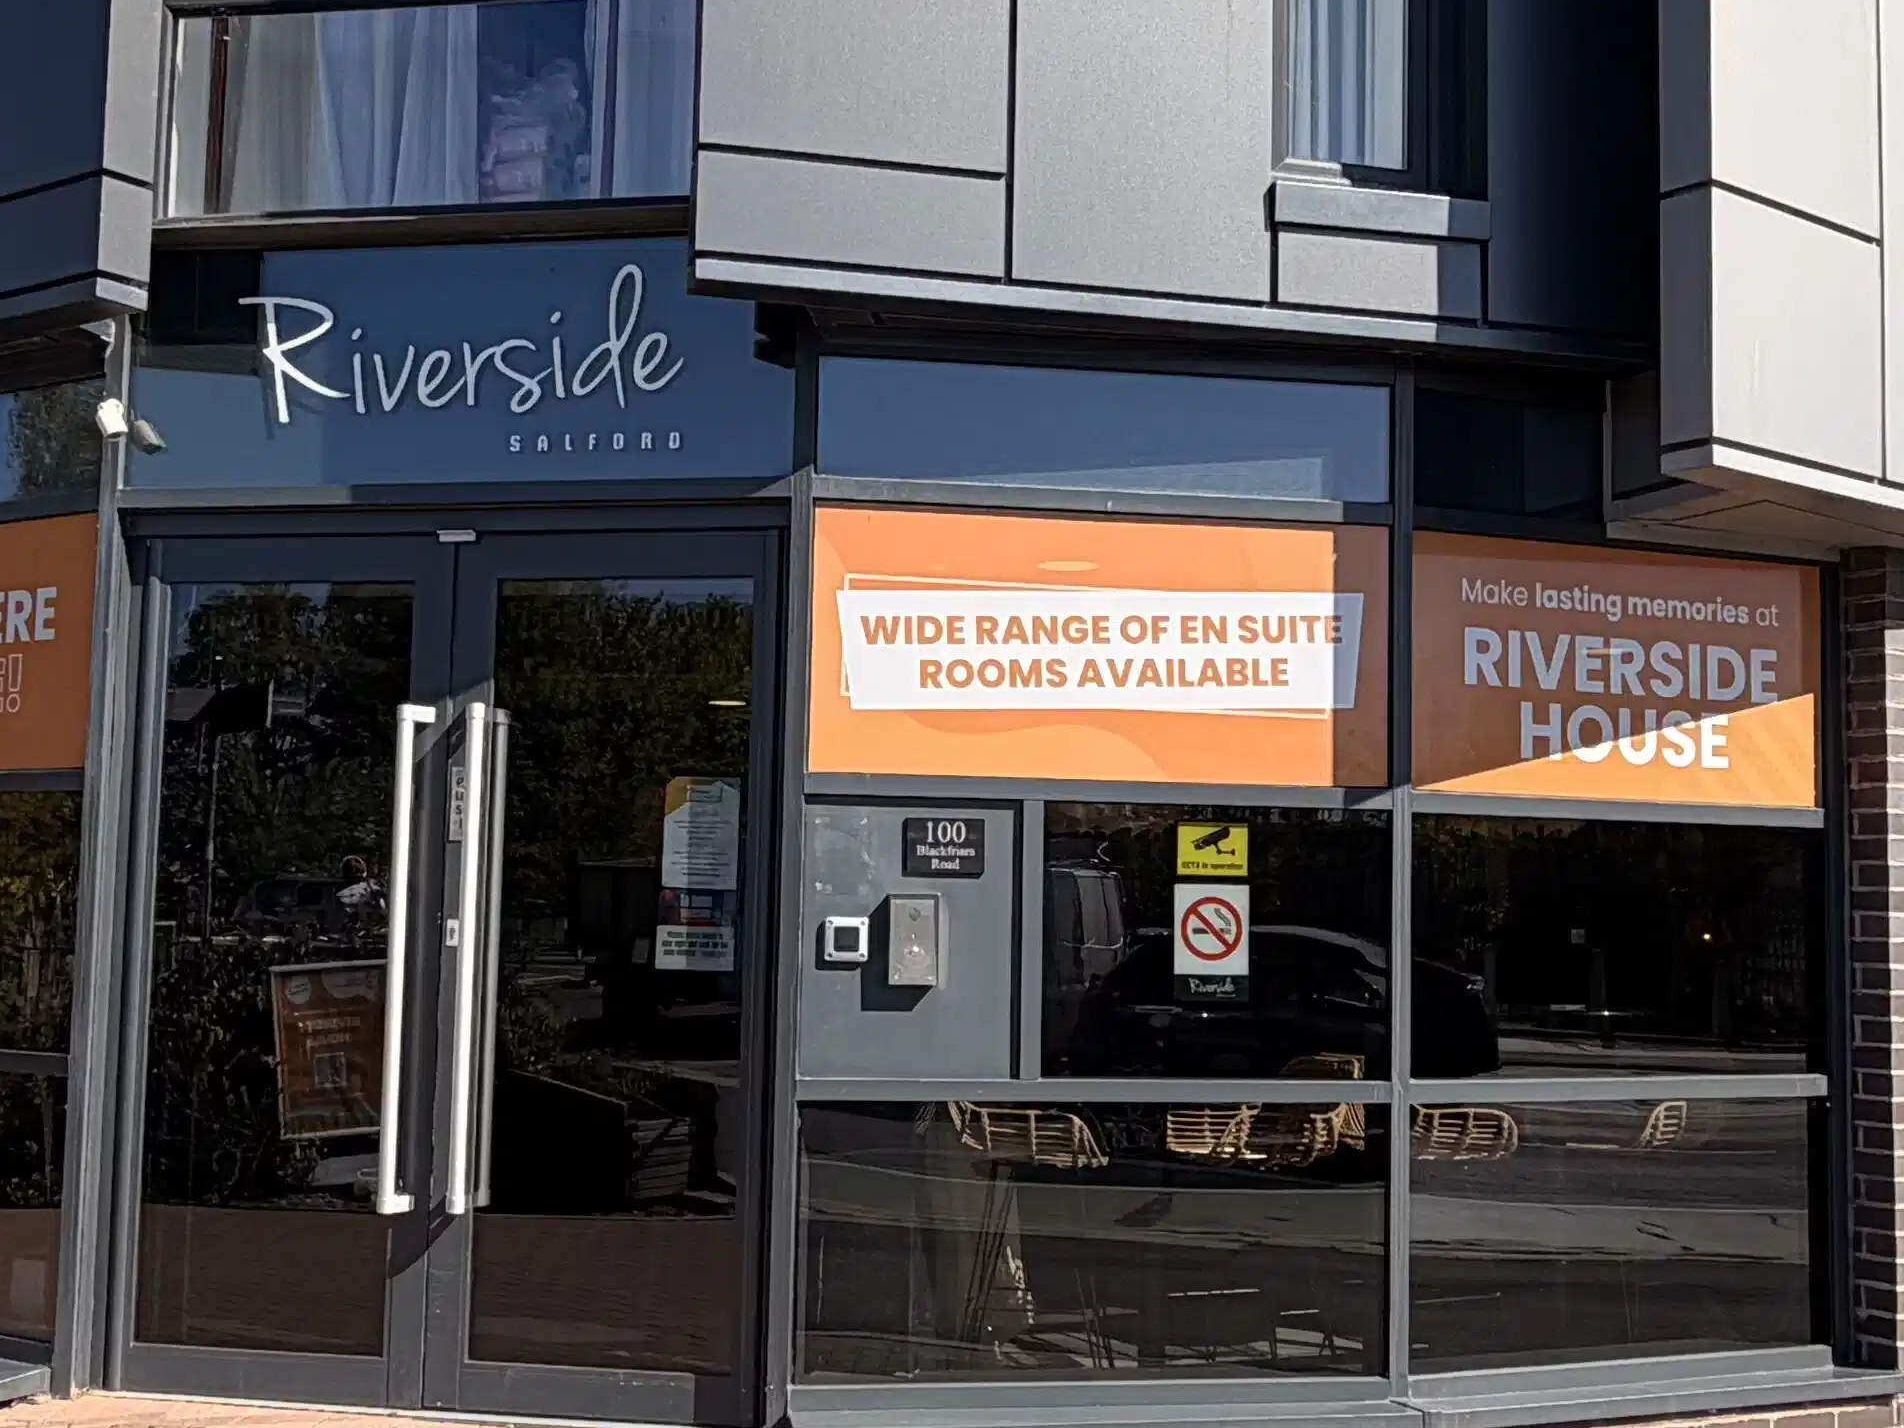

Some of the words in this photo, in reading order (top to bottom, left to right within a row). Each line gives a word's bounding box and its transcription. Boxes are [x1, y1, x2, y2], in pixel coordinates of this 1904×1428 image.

[238, 263, 685, 425] Riverside
[508, 430, 682, 453] SALFORD
[1460, 576, 1529, 607] Make
[1535, 581, 1623, 622] lasting
[1627, 595, 1750, 624] memories
[1755, 603, 1779, 627] at
[859, 615, 966, 645] WIDE
[975, 615, 1111, 645] RANGE
[1119, 615, 1170, 645] OF
[1179, 615, 1228, 644] EN
[1237, 614, 1343, 645] SUITE
[919, 658, 1068, 689] ROOMS
[1076, 657, 1290, 688] AVAILABLE
[1463, 625, 1779, 704] RIVERSIDE
[1520, 700, 1730, 769] HOUSE
[925, 820, 966, 843] 100
[931, 857, 961, 870] Road
